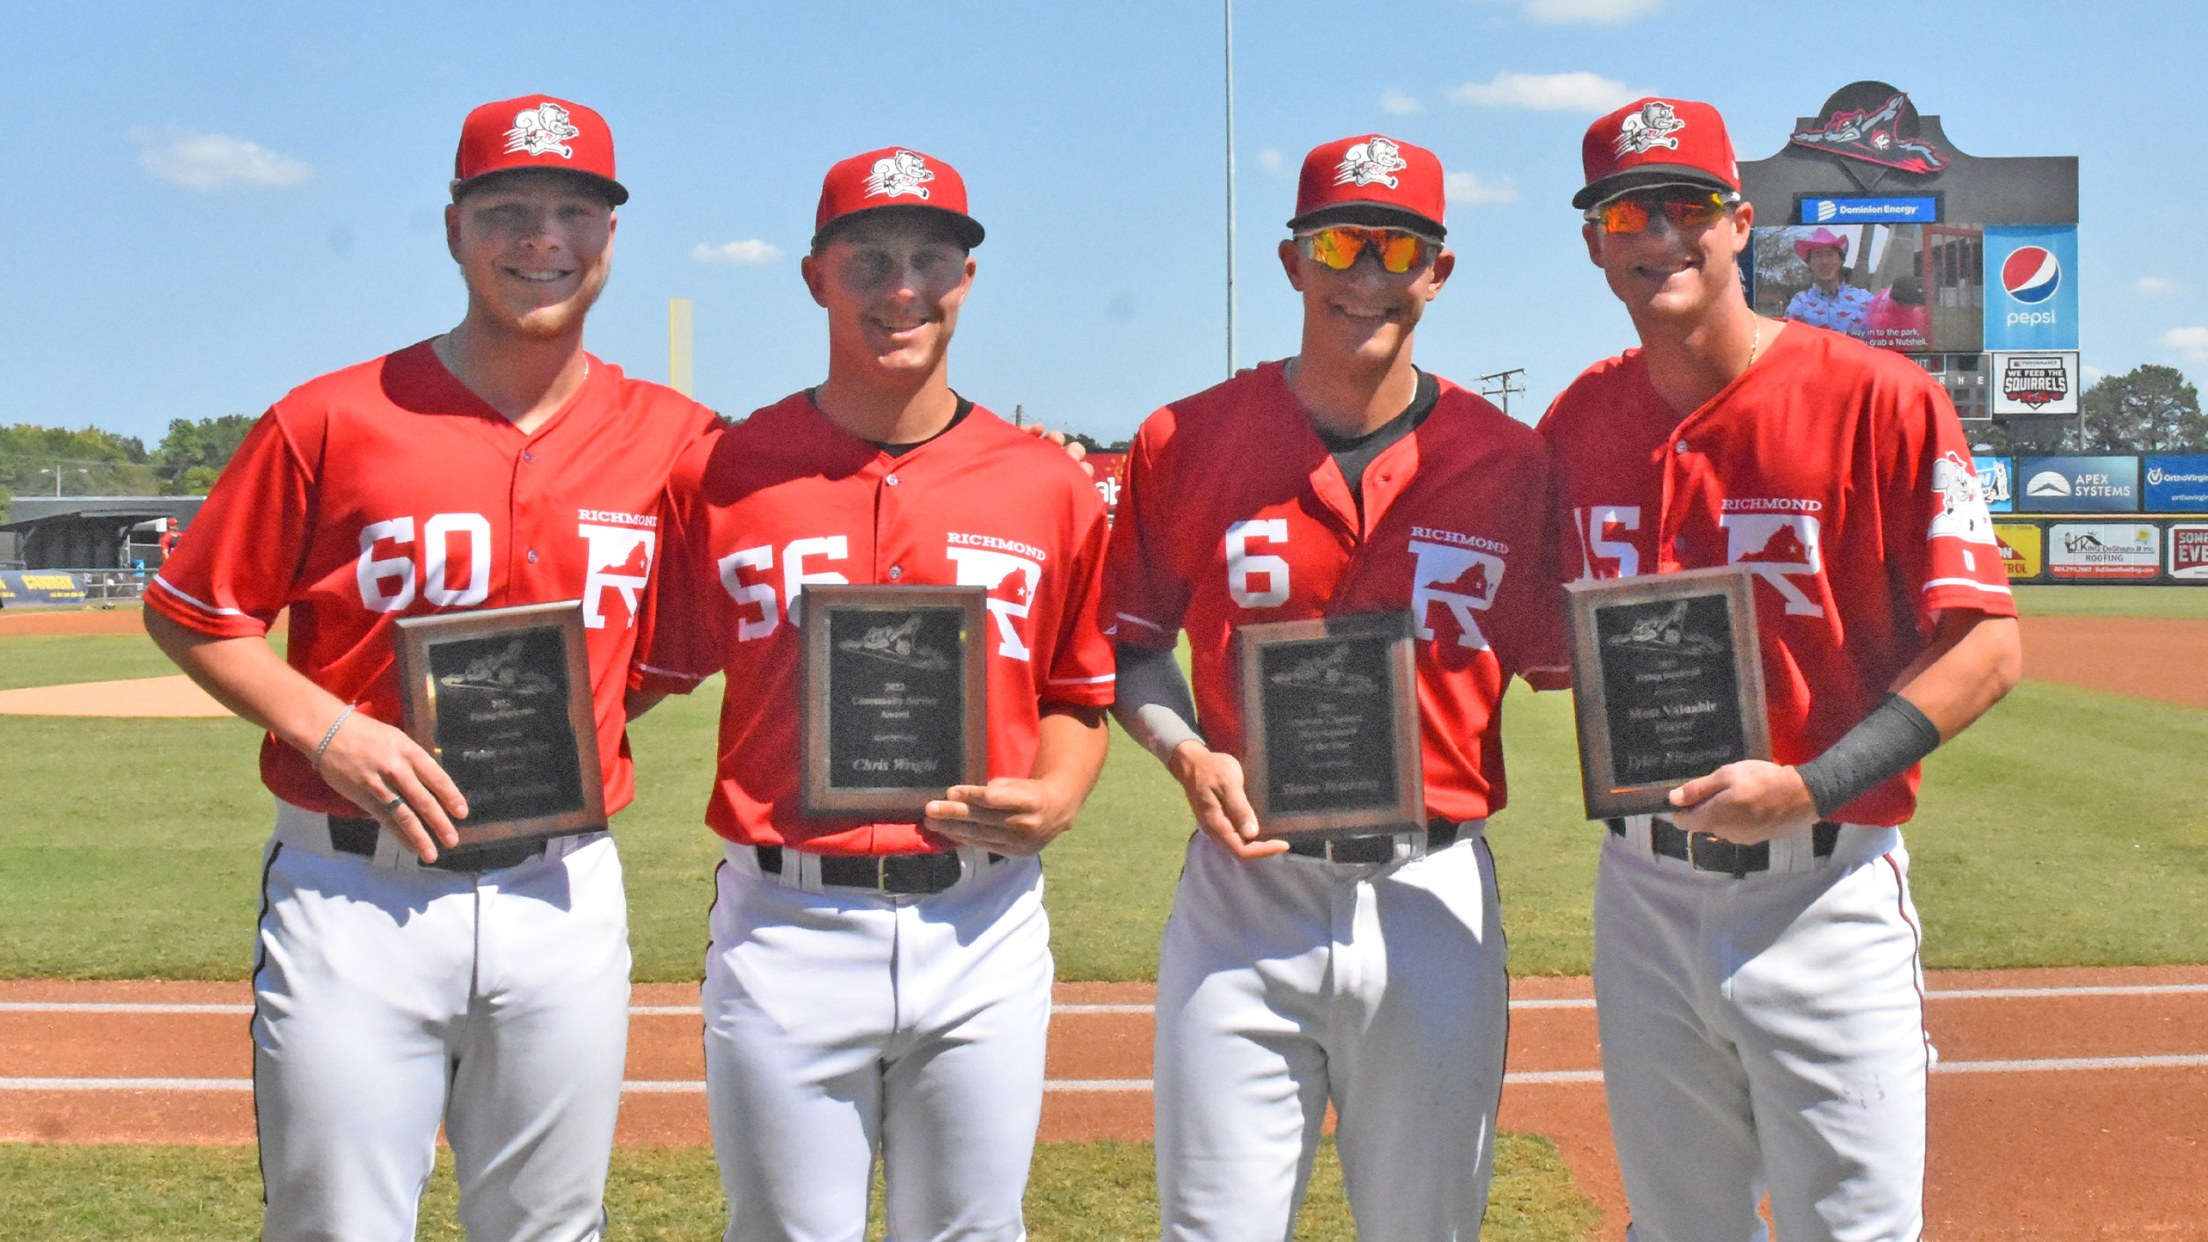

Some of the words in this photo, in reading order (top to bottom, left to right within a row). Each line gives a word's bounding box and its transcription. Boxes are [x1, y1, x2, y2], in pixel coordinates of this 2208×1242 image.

[1840, 205, 1883, 214] Dominion
[1884, 205, 1917, 215] Energy
[2006, 309, 2057, 327] pepsi
[1886, 328, 1900, 336] the
[1869, 338, 1887, 347] grab
[1939, 376, 1946, 384] R
[1957, 376, 1965, 384] H
[1977, 376, 1984, 384] E
[2005, 377, 2067, 393] SQUIRRELS
[2075, 474, 2109, 484] APEX
[2075, 486, 2131, 497] SYSTEMS
[1721, 498, 1822, 512] RICHMOND
[947, 532, 1046, 561] RICHMOND
[1410, 526, 1509, 554] RICHMOND
[356, 512, 491, 613] 60
[1225, 518, 1290, 609] 6
[2085, 554, 2124, 562] ROOFING
[853, 758, 889, 771] Chris
